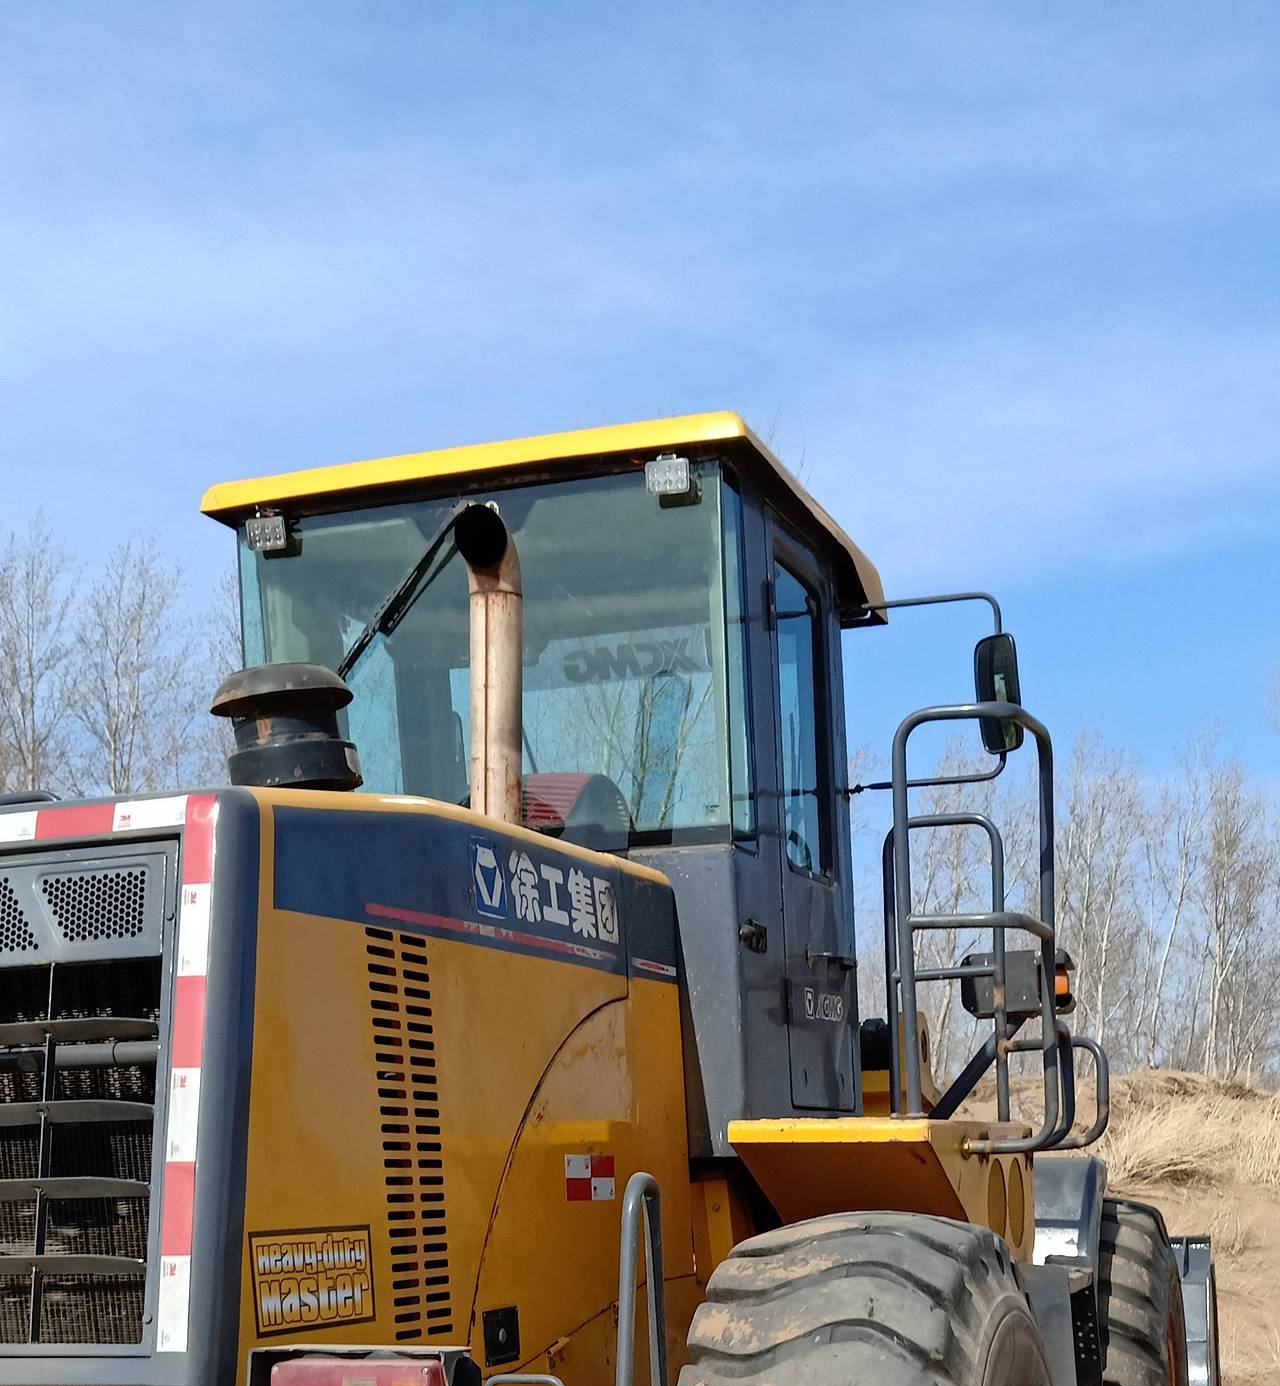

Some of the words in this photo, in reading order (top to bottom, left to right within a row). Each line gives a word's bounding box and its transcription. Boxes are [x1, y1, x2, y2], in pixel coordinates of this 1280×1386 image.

[508, 849, 620, 944] 徐工集团
[259, 1271, 369, 1327] Master
